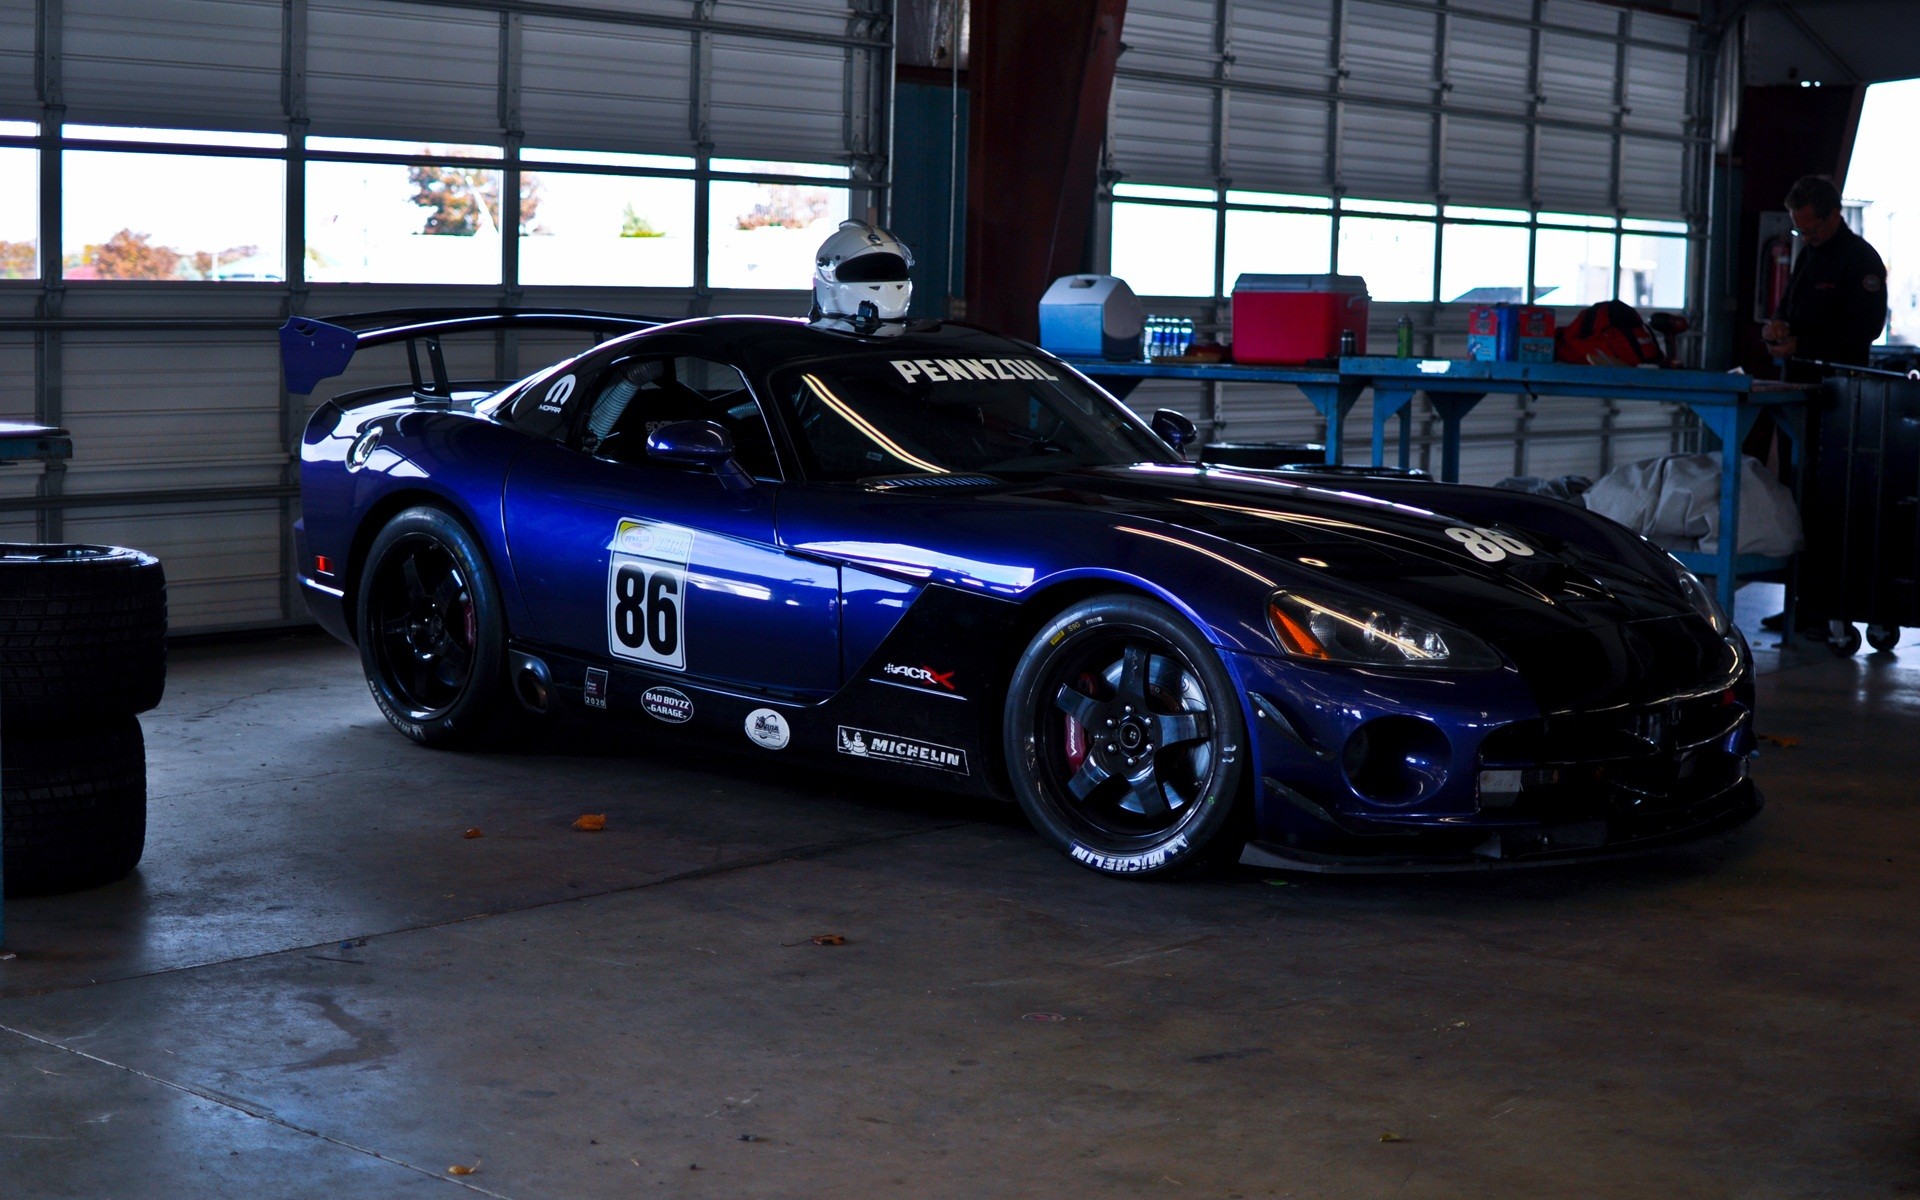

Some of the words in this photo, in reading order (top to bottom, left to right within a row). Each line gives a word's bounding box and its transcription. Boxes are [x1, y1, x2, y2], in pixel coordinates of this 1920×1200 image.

[889, 359, 1059, 384] PENNZOIL
[538, 404, 562, 414] MOPAR
[1444, 527, 1535, 563] 86
[615, 564, 678, 656] 86
[586, 696, 605, 707] 2020
[645, 692, 663, 703] BAD
[663, 696, 690, 710] BOYZZ
[650, 703, 685, 719] GARAGE
[871, 738, 960, 766] MICHELIN
[1071, 845, 1166, 872] MICHELIN
